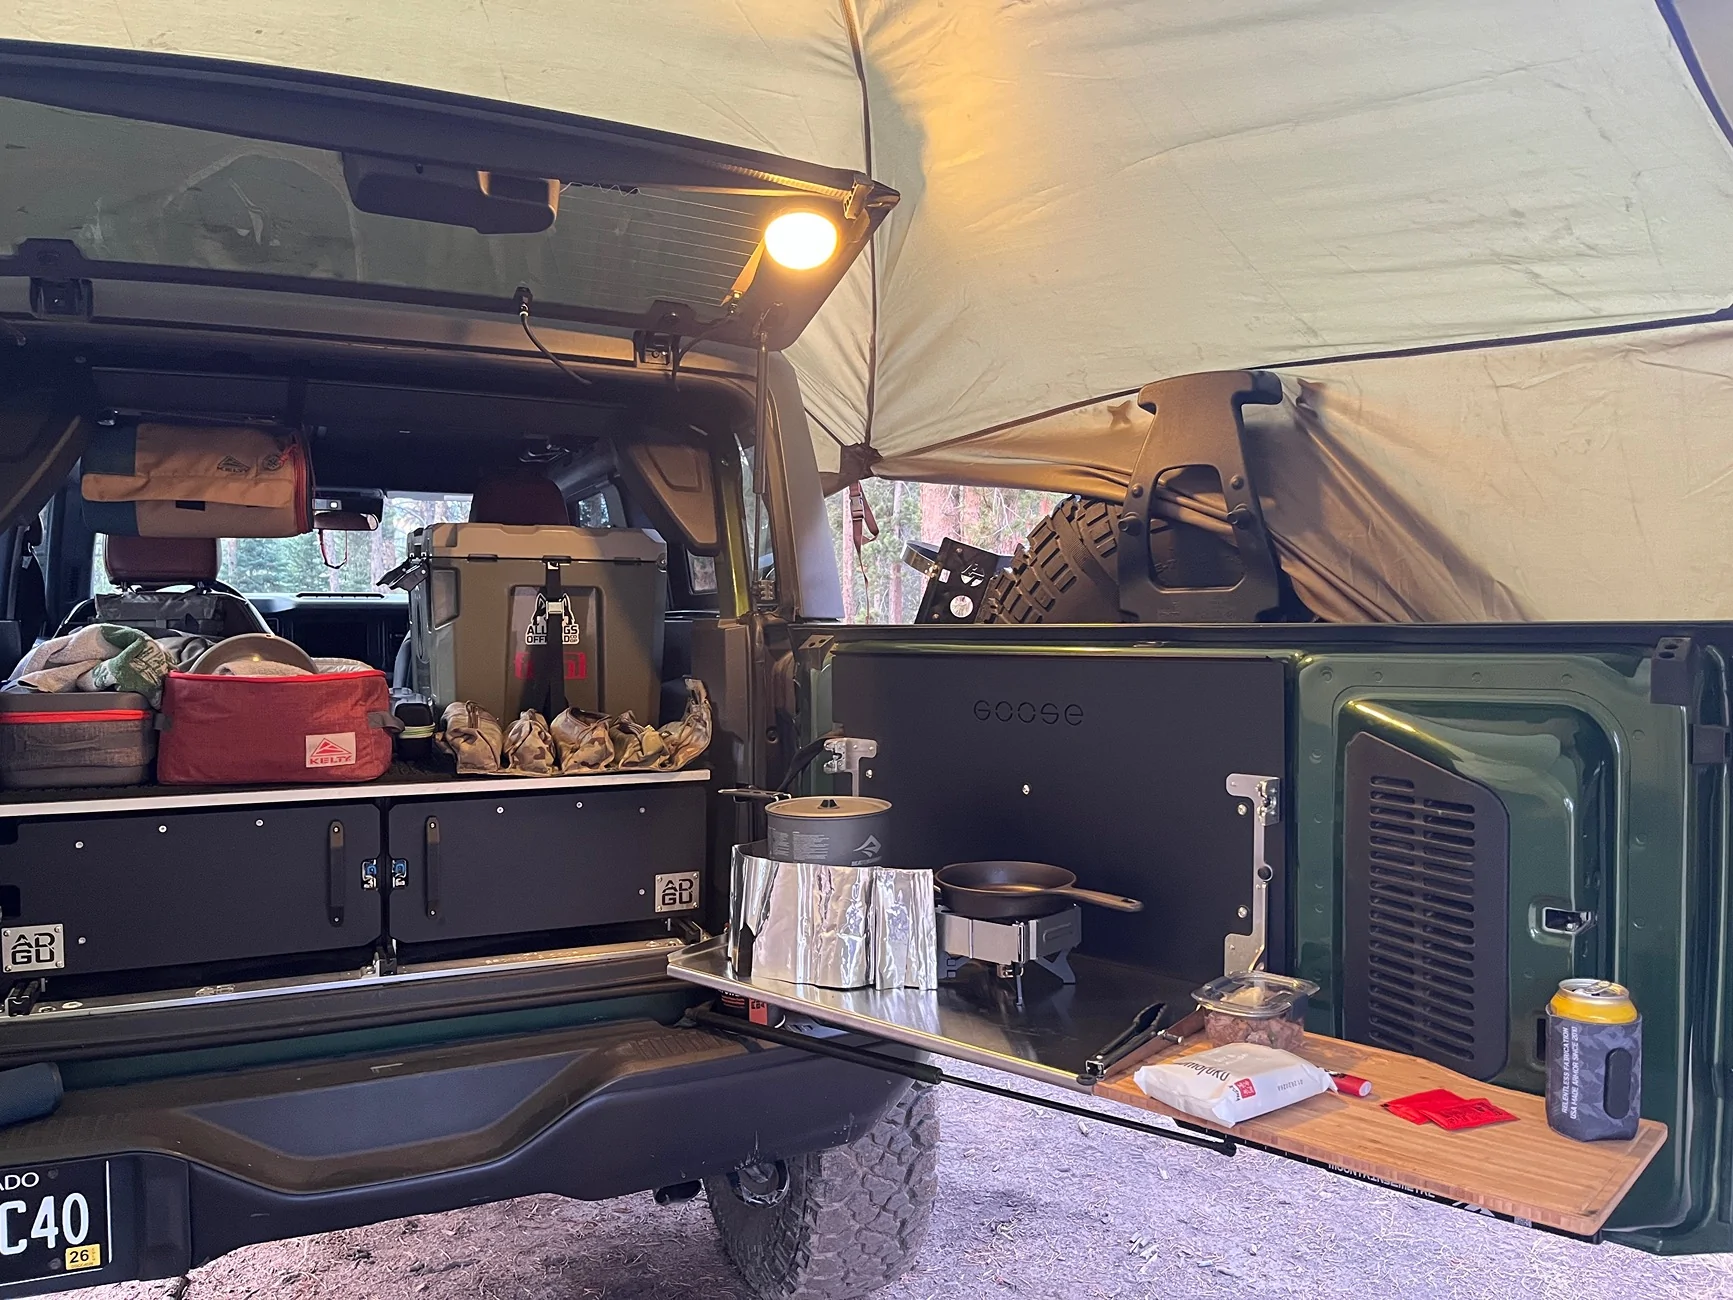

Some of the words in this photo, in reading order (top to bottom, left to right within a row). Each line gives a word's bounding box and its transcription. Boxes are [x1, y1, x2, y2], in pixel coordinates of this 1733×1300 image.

[310, 755, 353, 765] KELTY
[1571, 1042, 1579, 1062] SINCE
[1561, 1072, 1570, 1114] RELENTLESS
[1571, 1086, 1579, 1106] MADE
[69, 1249, 90, 1264] 26
